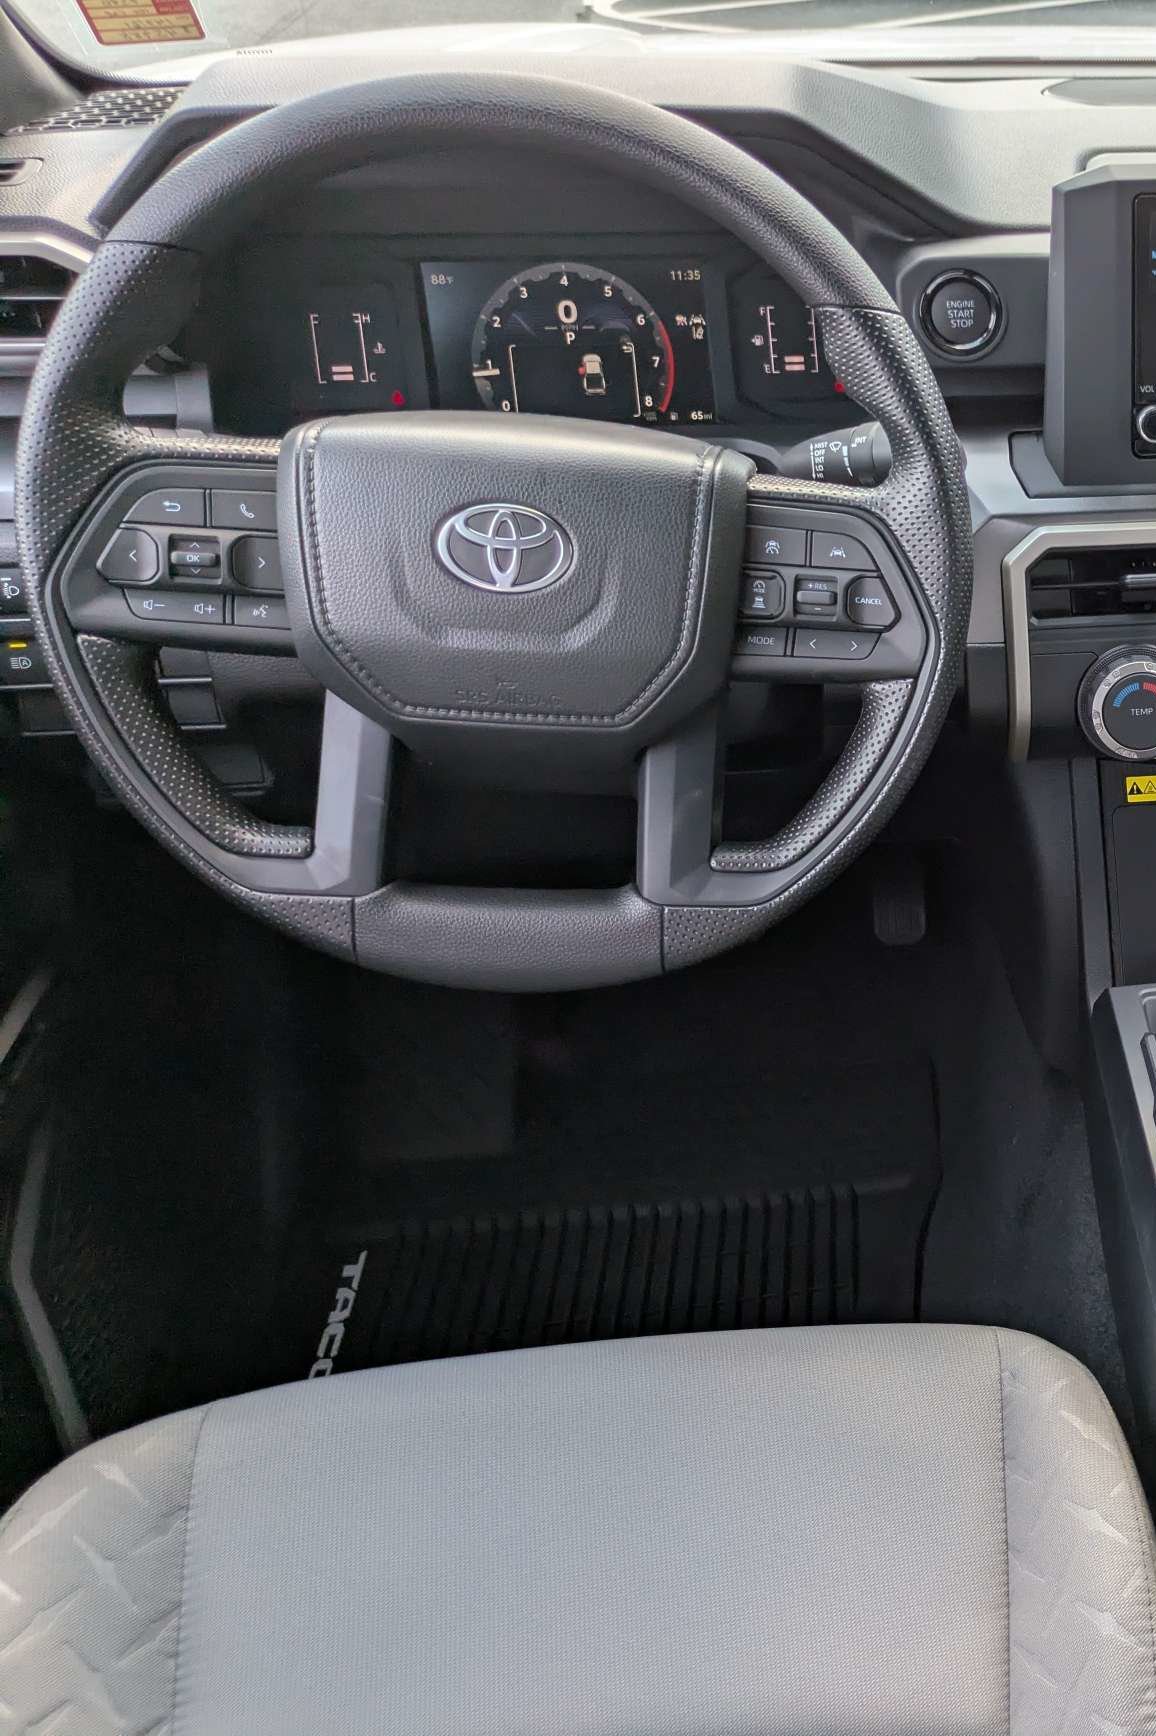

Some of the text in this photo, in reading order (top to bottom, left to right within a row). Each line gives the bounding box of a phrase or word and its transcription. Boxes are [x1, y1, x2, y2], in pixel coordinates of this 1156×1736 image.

[560, 275, 569, 287] 4
[671, 270, 701, 281] 11:35
[520, 287, 528, 298] 3
[604, 286, 613, 297] 5
[946, 300, 976, 310] ENGINE
[557, 299, 578, 324] 0
[947, 310, 975, 319] START
[491, 316, 501, 328] 2
[636, 314, 645, 326] 6
[951, 319, 974, 329] STOP
[566, 332, 576, 345] P
[651, 355, 661, 368] 7
[1140, 385, 1154, 393] VOL
[501, 400, 511, 412] 0
[644, 395, 653, 407] 8
[691, 411, 704, 420] 65
[814, 449, 826, 457] OFF
[815, 456, 825, 464] INT
[815, 464, 824, 472] LO
[187, 553, 200, 564] OK
[855, 596, 882, 606] CANCEL
[748, 635, 776, 646] MODE
[1130, 707, 1154, 717] TEMP
